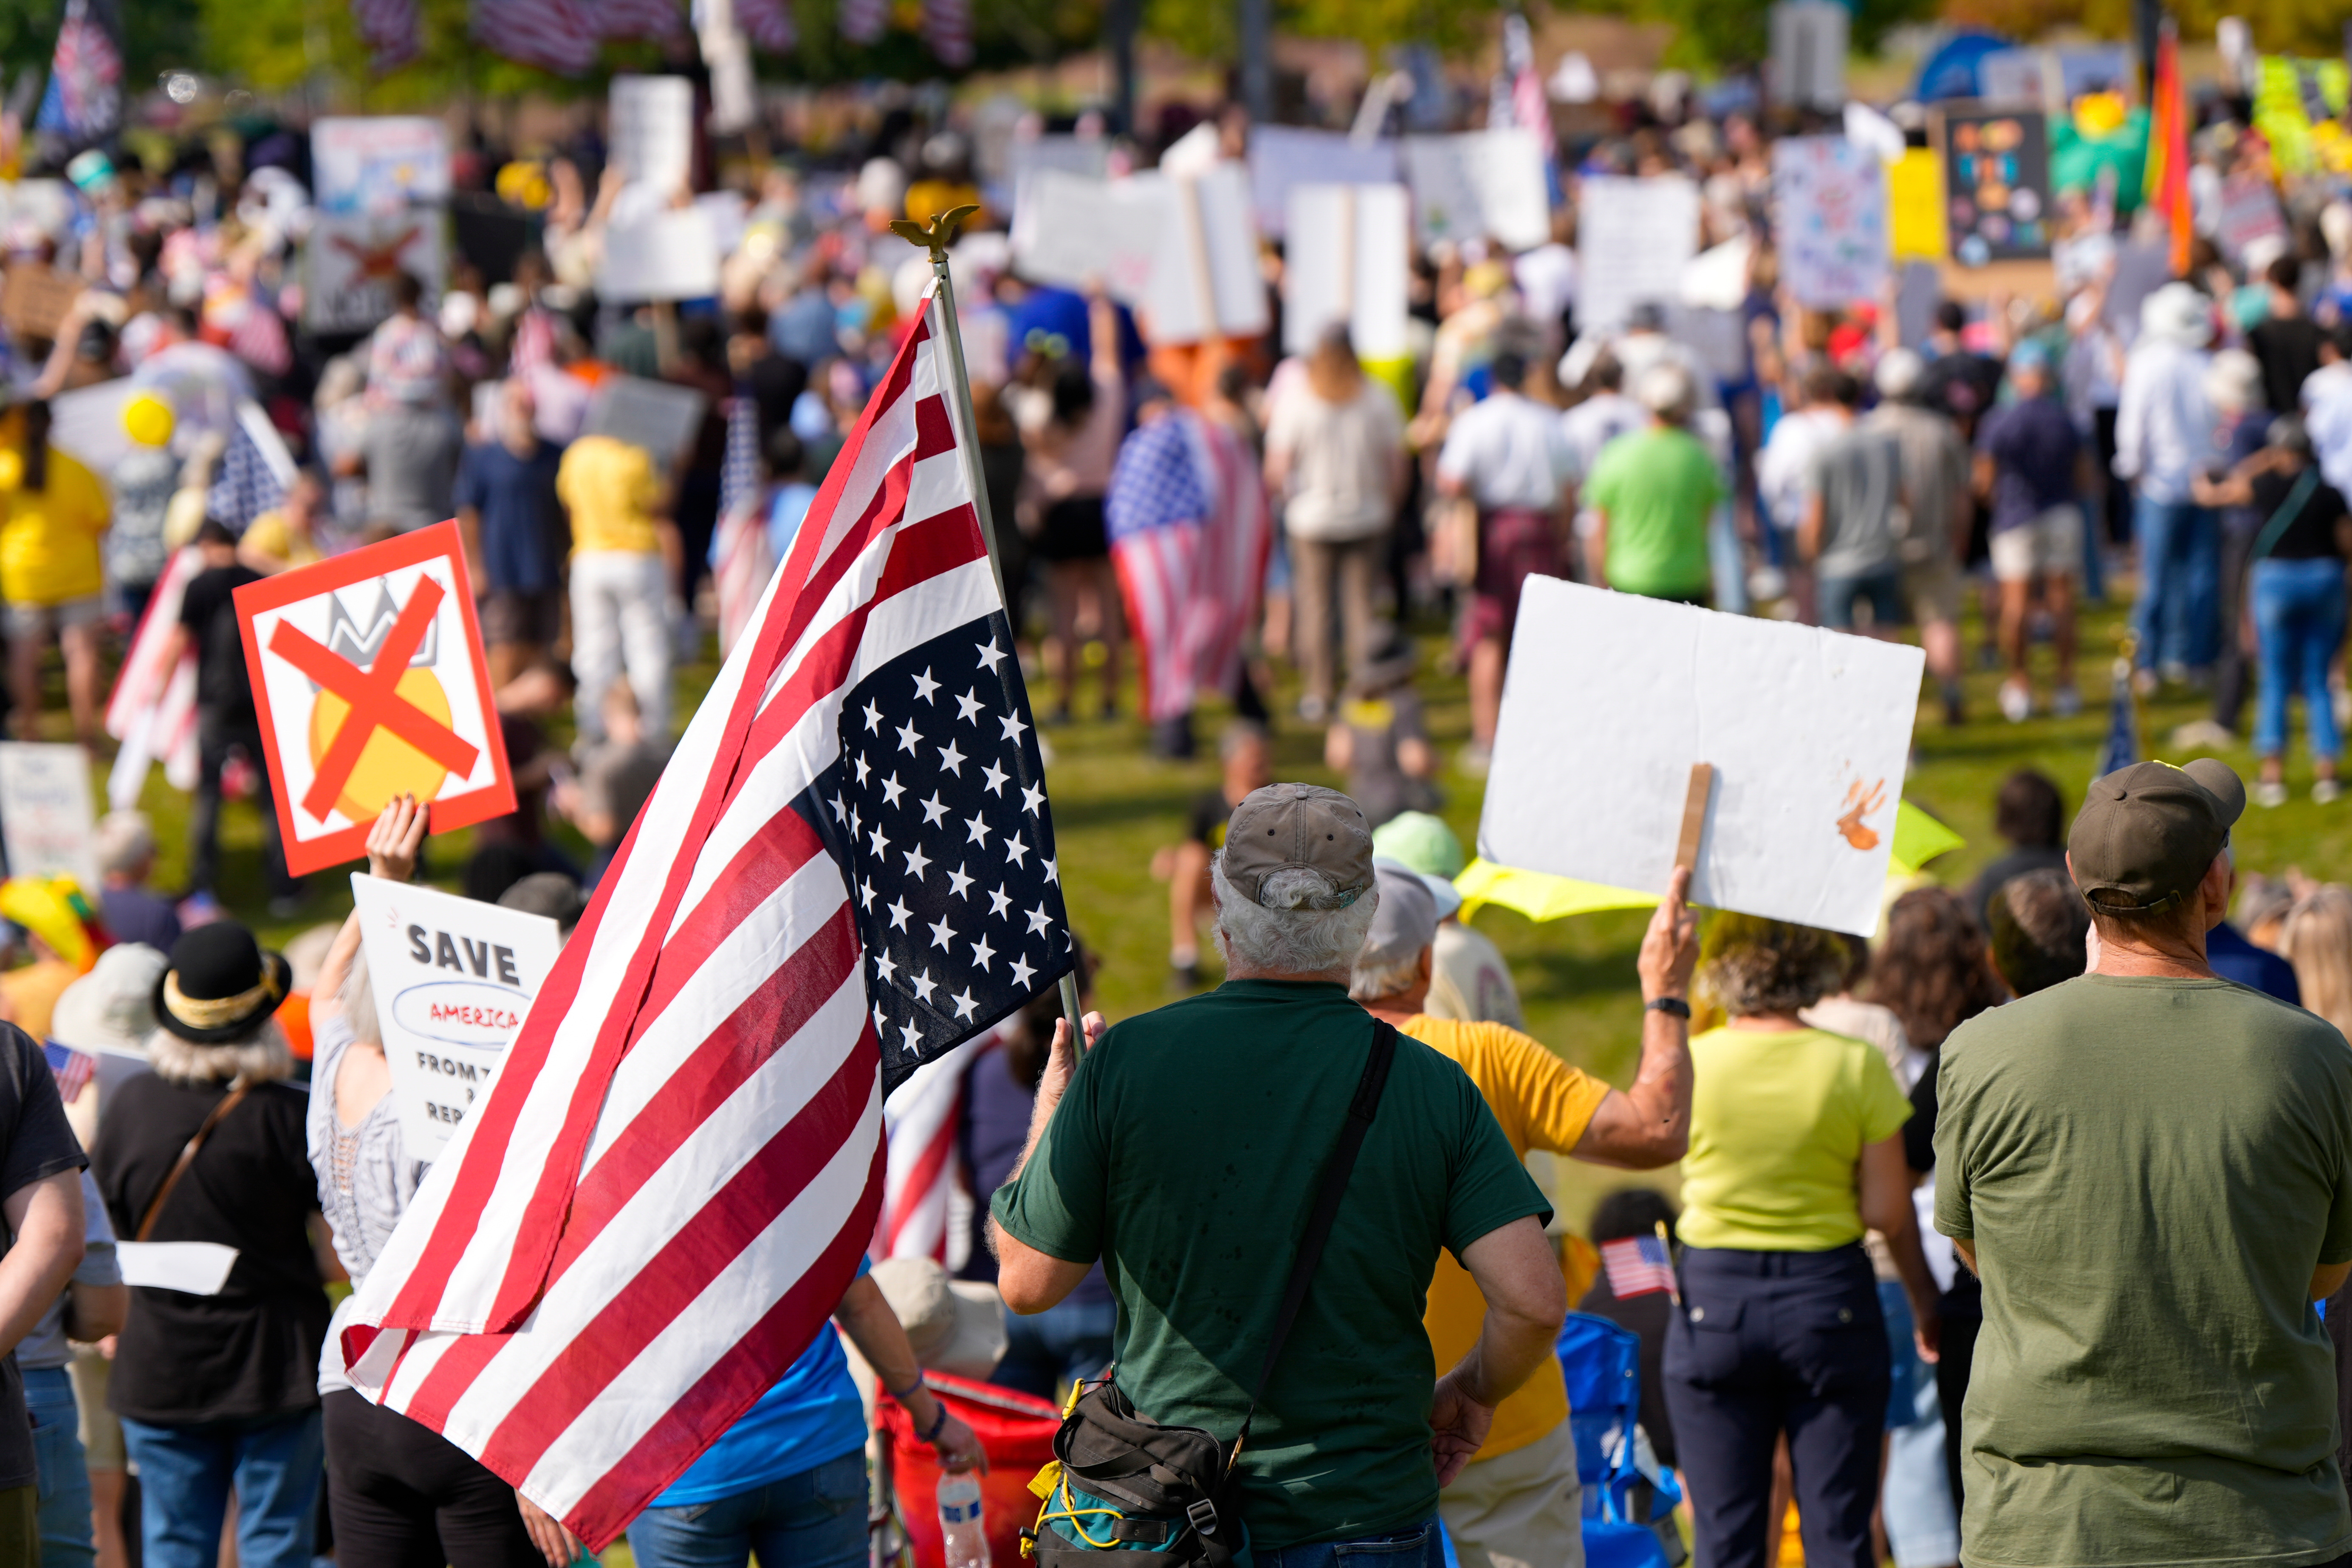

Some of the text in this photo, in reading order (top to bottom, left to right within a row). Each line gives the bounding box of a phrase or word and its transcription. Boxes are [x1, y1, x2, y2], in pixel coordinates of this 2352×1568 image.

[406, 923, 520, 987] SAVE
[429, 1003, 519, 1029] AMERICA
[415, 1050, 477, 1083] FROM
[425, 1100, 466, 1126] REP
